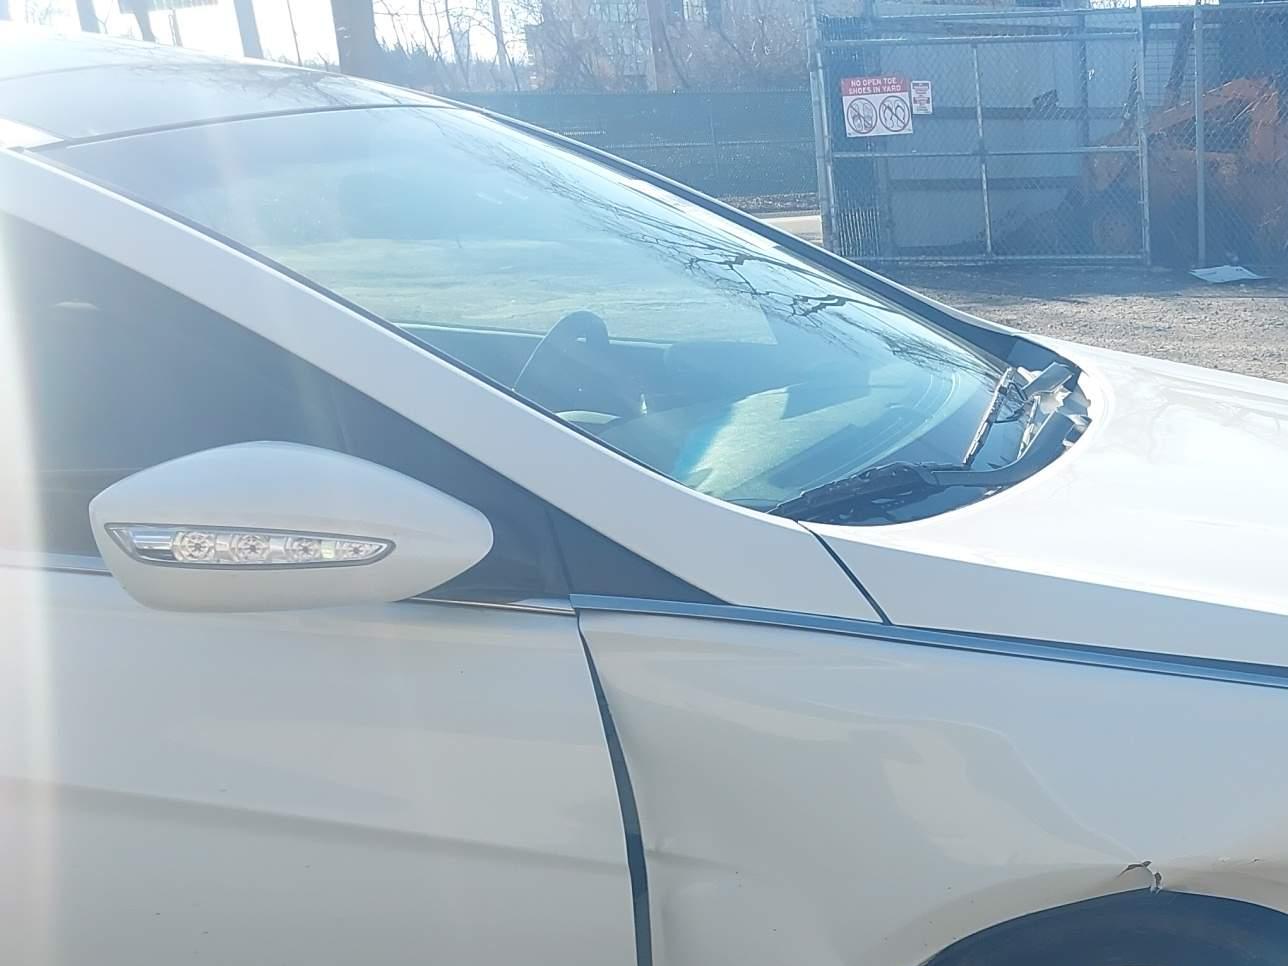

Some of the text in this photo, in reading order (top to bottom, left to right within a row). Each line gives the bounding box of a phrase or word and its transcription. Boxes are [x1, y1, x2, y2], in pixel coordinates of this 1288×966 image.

[851, 79, 861, 87] NO
[863, 78, 881, 86] OPEN
[849, 87, 871, 95] SHOES
[882, 84, 901, 92] YARD
